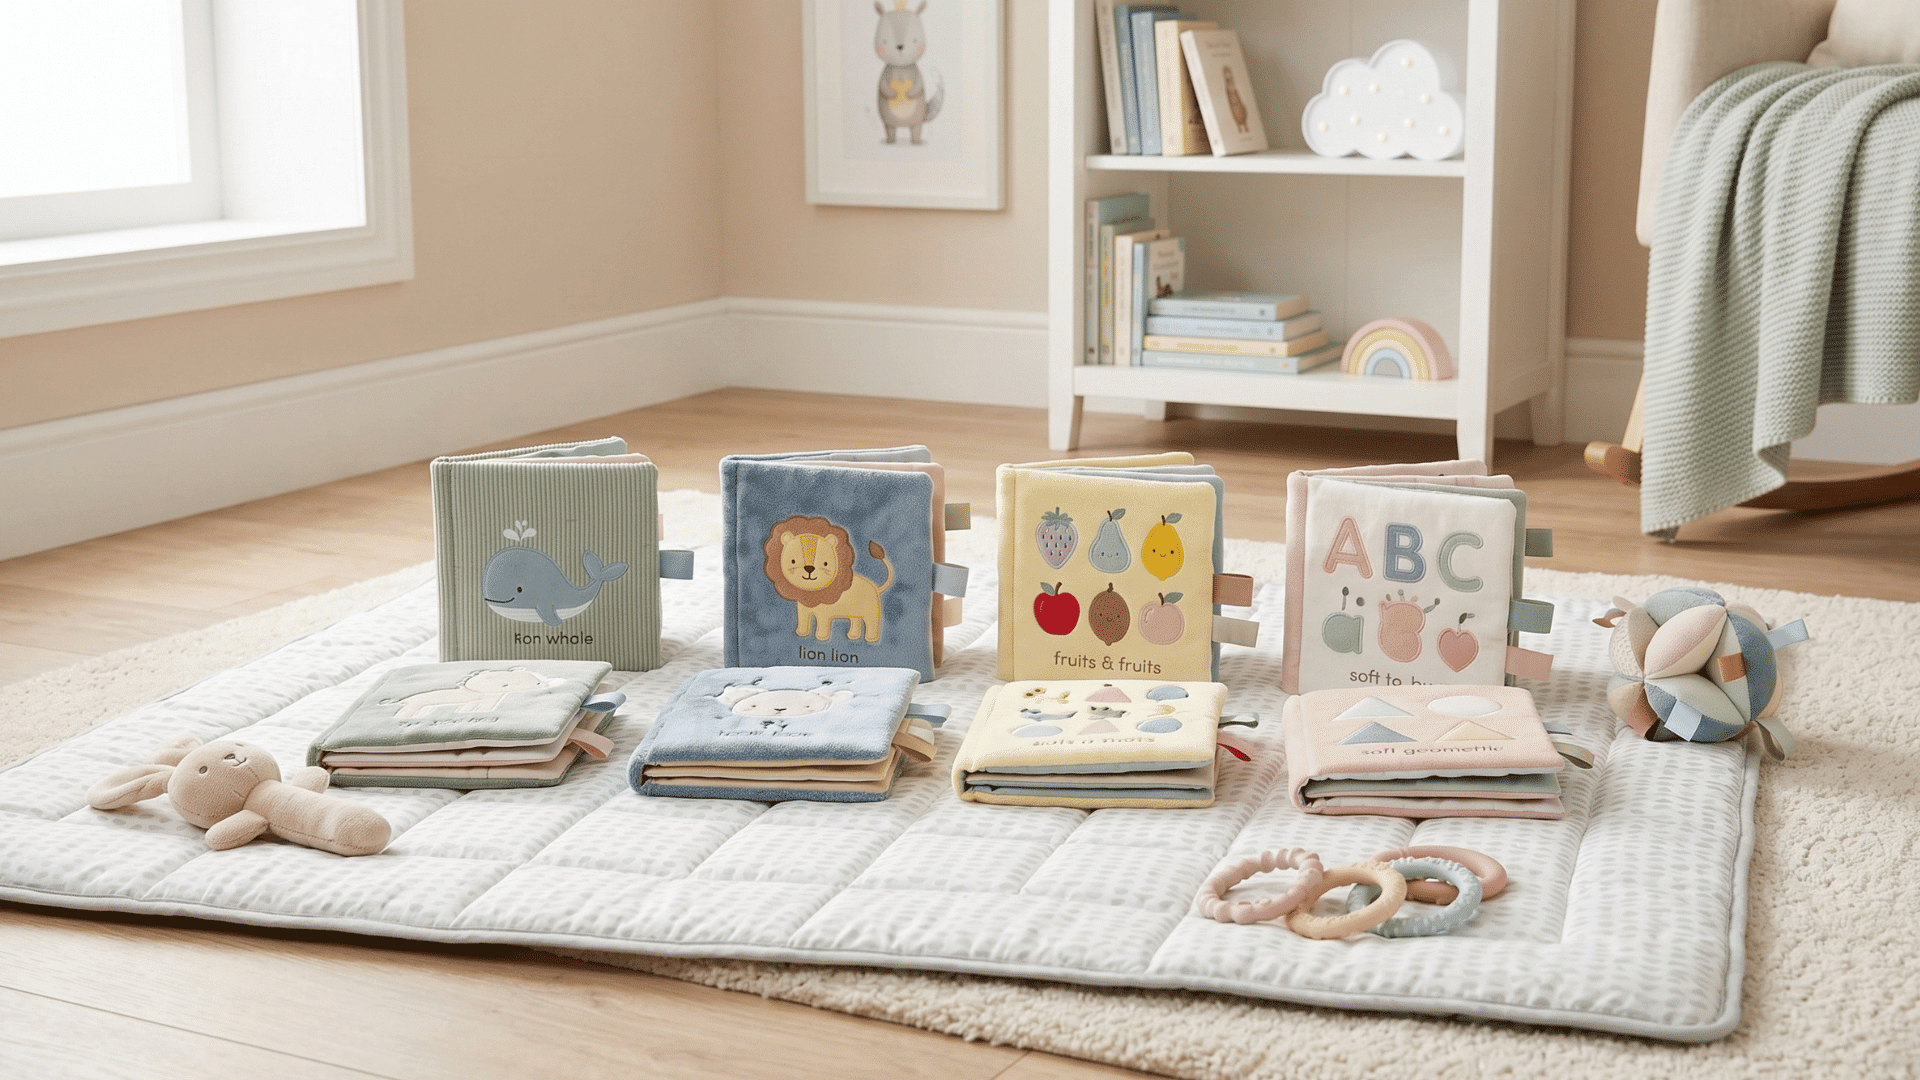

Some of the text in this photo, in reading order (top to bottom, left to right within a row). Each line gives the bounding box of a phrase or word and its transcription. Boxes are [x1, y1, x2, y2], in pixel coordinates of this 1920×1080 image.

[1323, 516, 1484, 593] ABC
[799, 645, 859, 663] lion lion
[1054, 651, 1161, 675] fruits & fruits
[1350, 669, 1381, 685] soft
[1385, 672, 1402, 686] to
